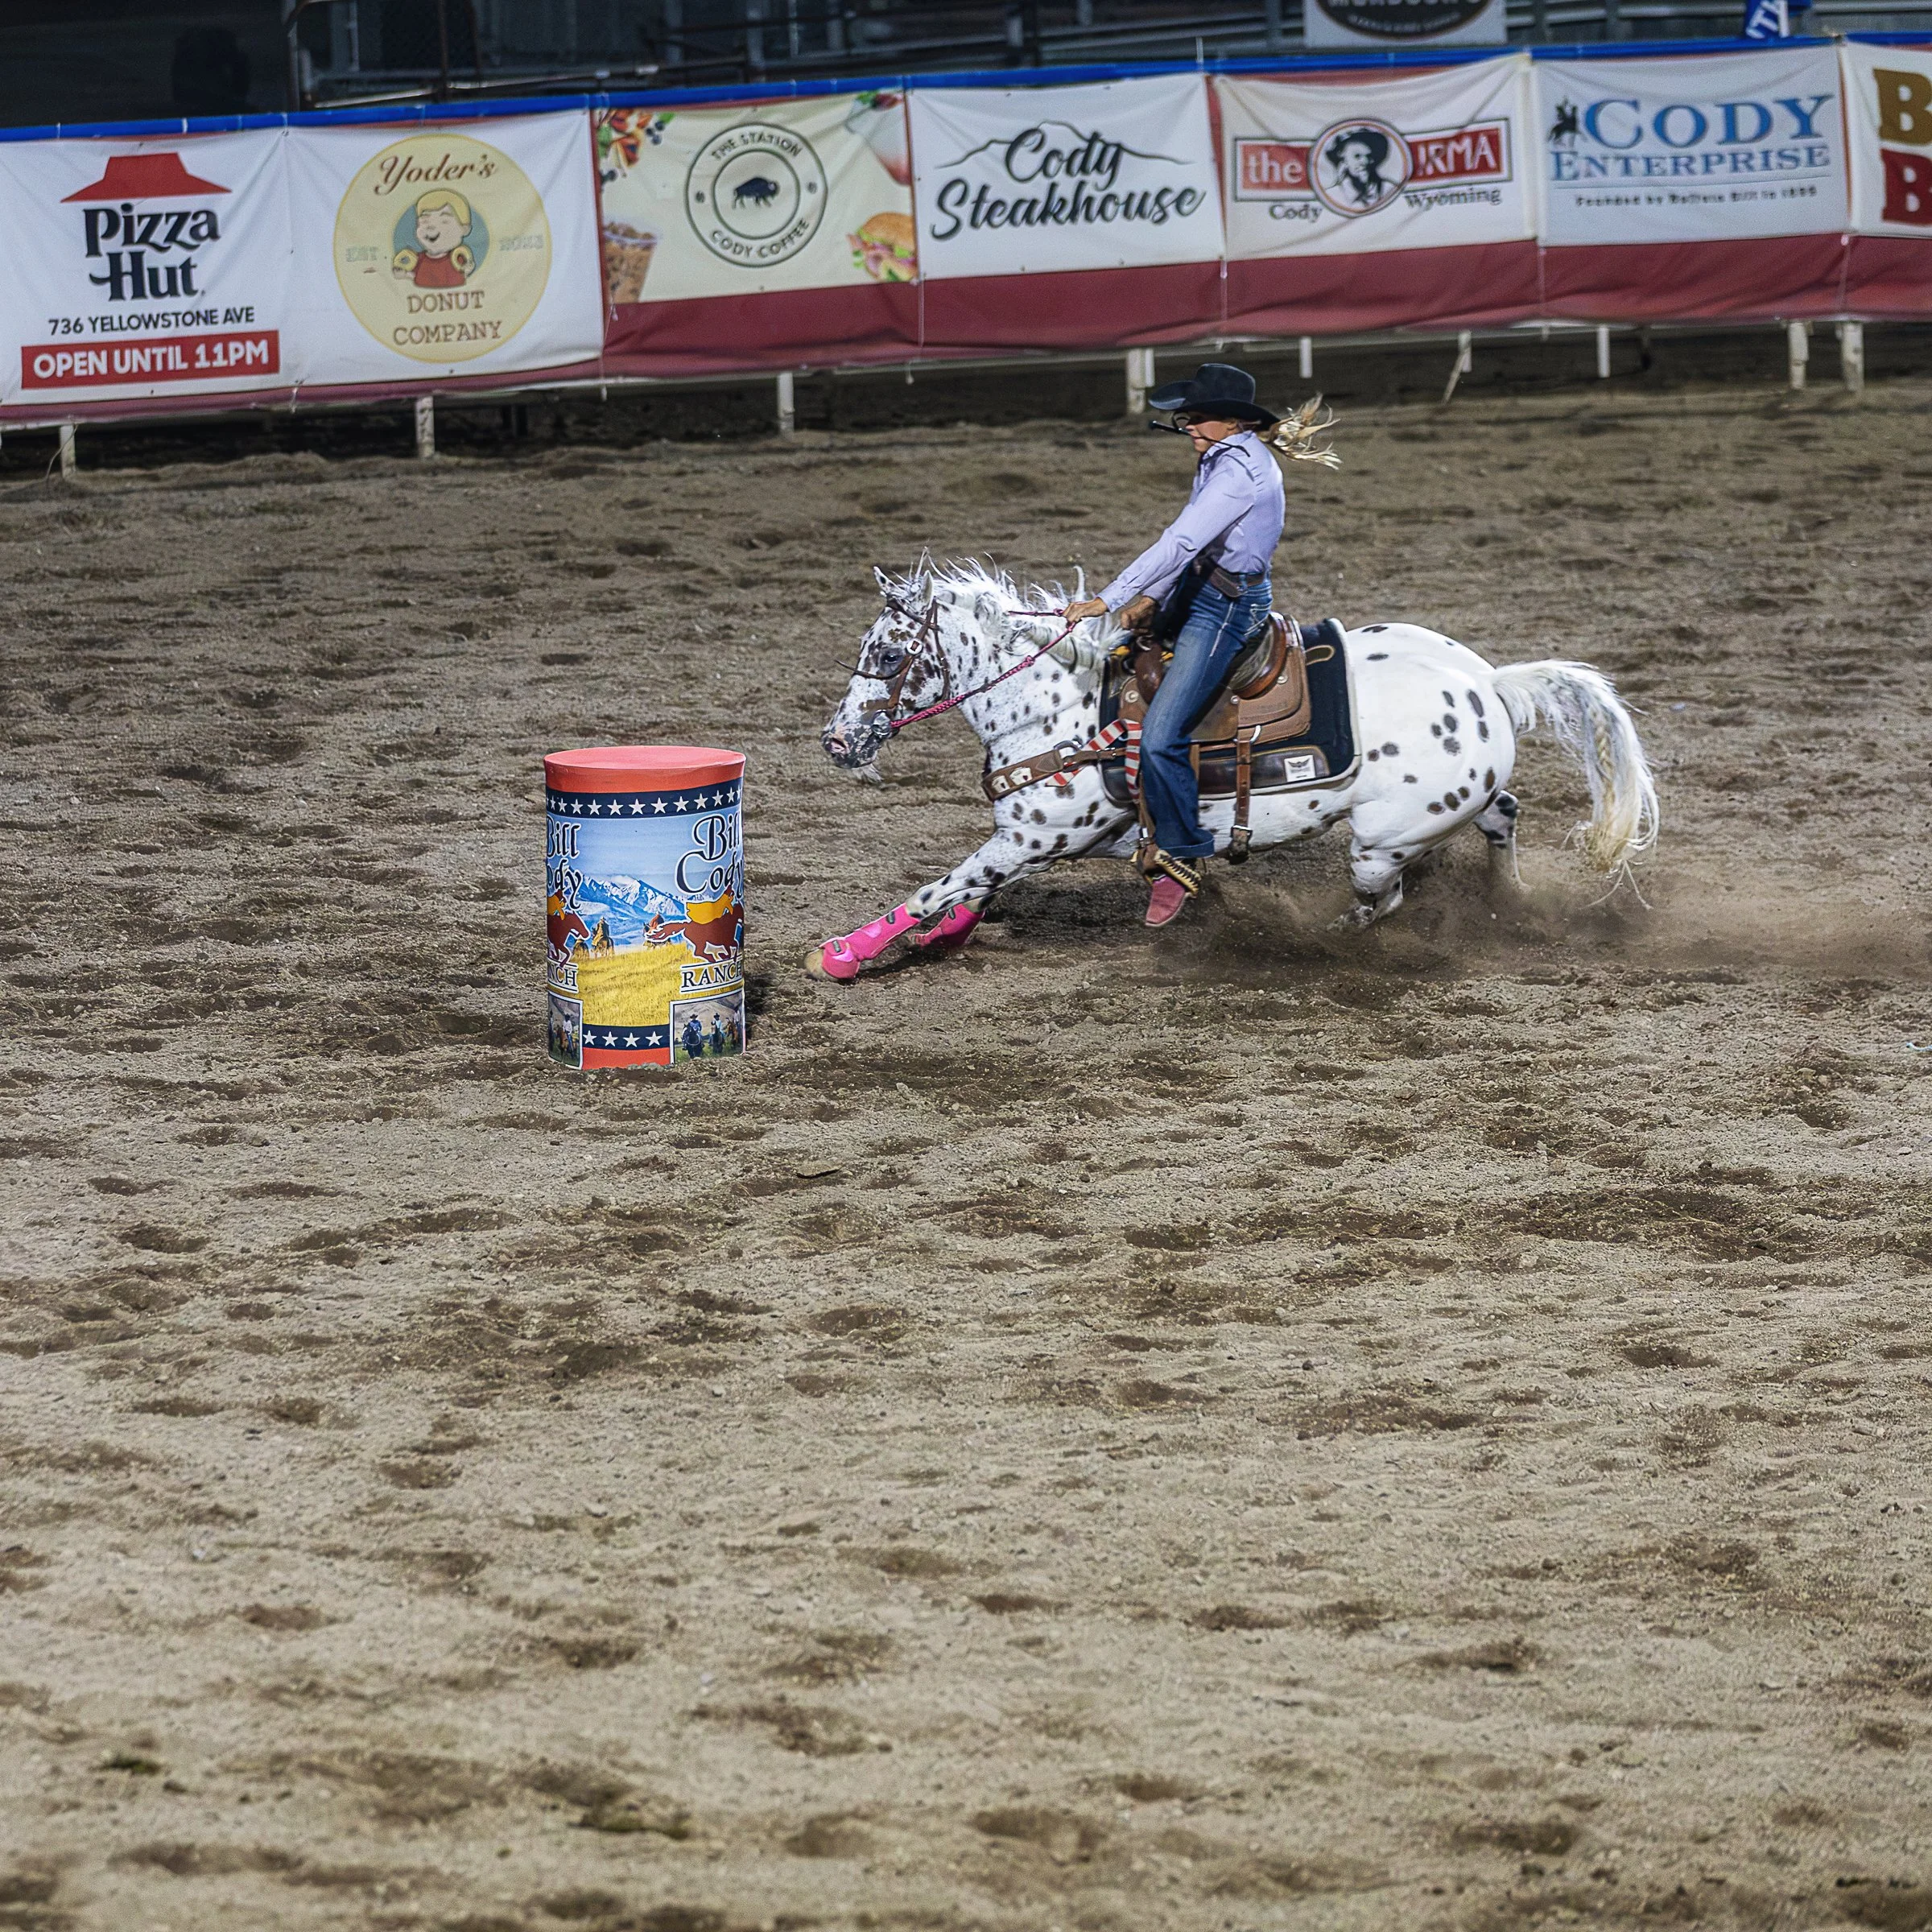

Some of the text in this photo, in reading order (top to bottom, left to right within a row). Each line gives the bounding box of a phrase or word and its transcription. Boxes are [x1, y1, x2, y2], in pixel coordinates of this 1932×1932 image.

[1584, 94, 1835, 150] CODY
[712, 132, 803, 159] THE STATION
[1006, 129, 1123, 192] Cody
[1551, 144, 1831, 181] ENTERPRISE
[374, 153, 496, 196] Yoder's
[1249, 151, 1303, 184] the
[931, 179, 1207, 242] Steakhouse
[1269, 188, 1502, 223] Cody Wyoming
[83, 202, 221, 258] Pizza
[712, 217, 810, 258] CODY COFFEE
[89, 249, 199, 302] Hut
[48, 307, 254, 335] 736 YELLOWSTONE AVE
[407, 291, 485, 314] DONUT
[393, 320, 502, 345] COMPANY
[33, 339, 269, 378] OPEN UNTIL 11PM
[676, 850, 742, 898] Cody
[682, 960, 741, 988] RANCH
